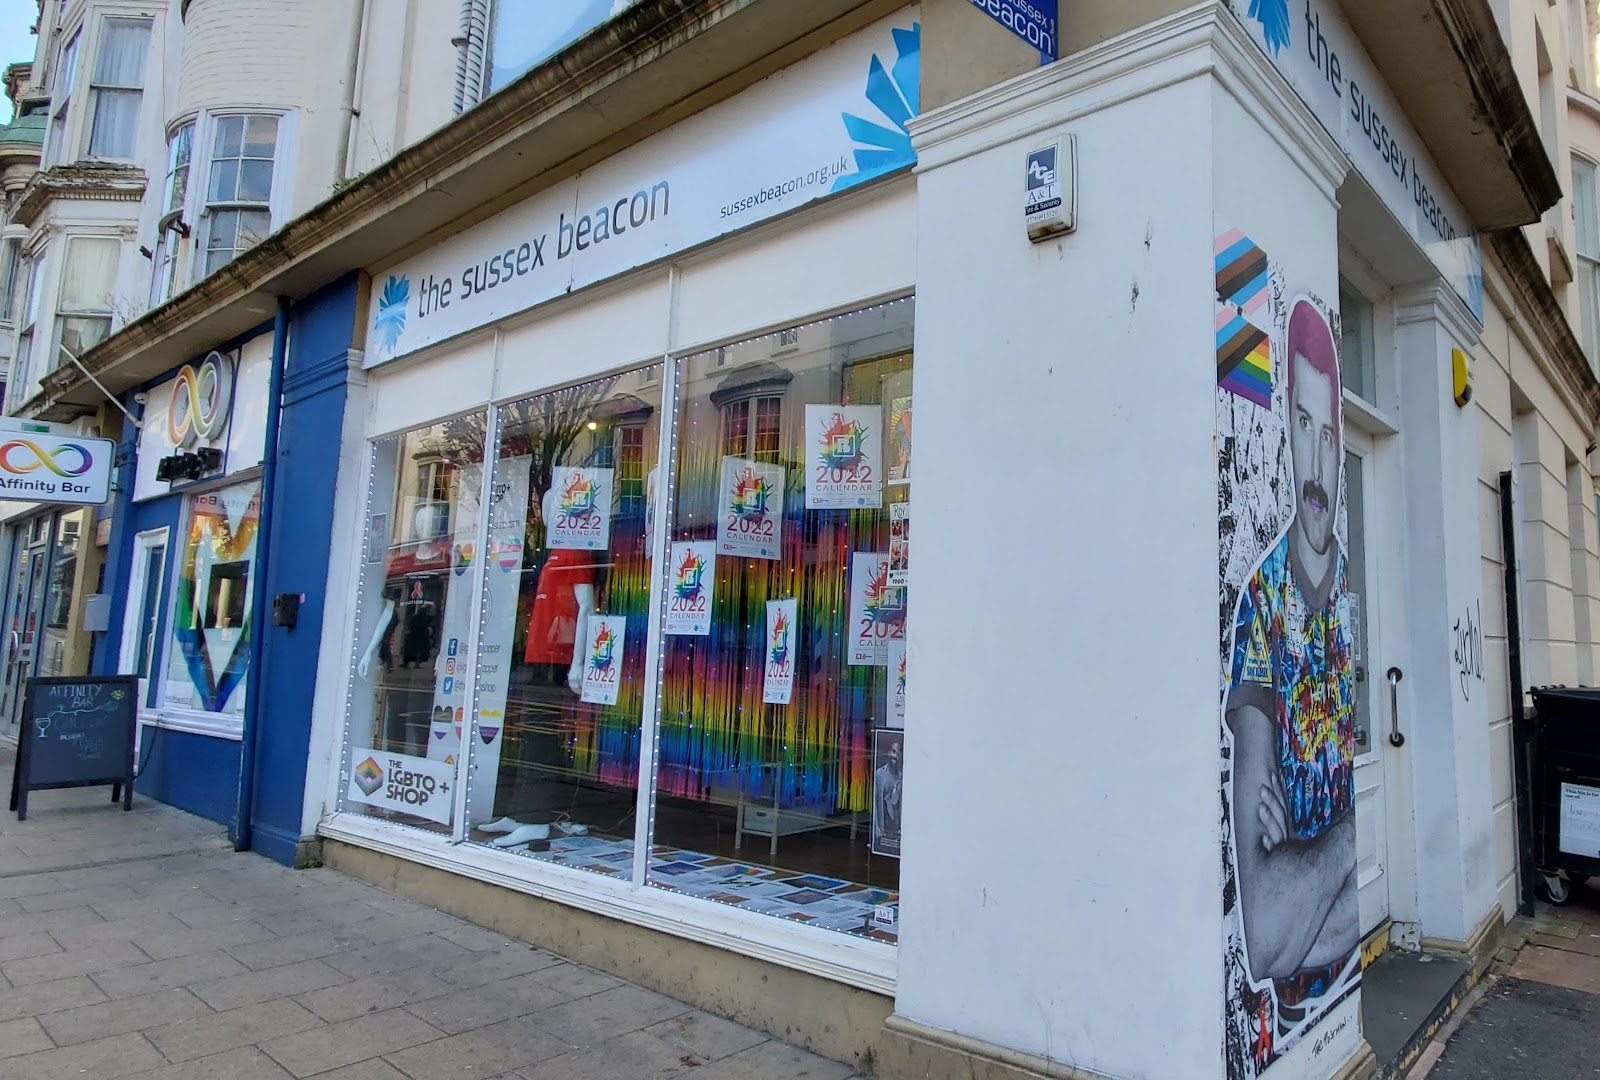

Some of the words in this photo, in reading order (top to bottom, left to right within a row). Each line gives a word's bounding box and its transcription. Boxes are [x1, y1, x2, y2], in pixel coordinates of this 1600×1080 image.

[1007, 0, 1048, 28] ussex
[1305, 0, 1342, 98] the
[1350, 80, 1408, 190] sussex
[1412, 157, 1456, 254] beacon
[1029, 160, 1054, 184] ACE
[720, 156, 848, 220] sussexbeacon.org.uk
[418, 274, 452, 318] the
[460, 233, 547, 300] sussex
[557, 180, 670, 260] beacon
[815, 465, 872, 484] 2022
[0, 477, 56, 494] Affinity
[61, 482, 91, 494] Bar
[815, 484, 873, 492] CALENDAR
[556, 514, 602, 529] 2022
[727, 514, 774, 536] 2022
[555, 529, 601, 537] CALENDAR
[726, 532, 773, 544] CALENDAR
[671, 595, 706, 611] 2022
[860, 618, 905, 639] 202
[587, 665, 616, 682] 2022
[768, 660, 790, 678] 2022
[49, 684, 102, 697] AFFINITY
[71, 695, 95, 708] BAR
[388, 759, 402, 769] THE
[388, 768, 436, 795] LGBTQ
[386, 784, 429, 806] SHOP
